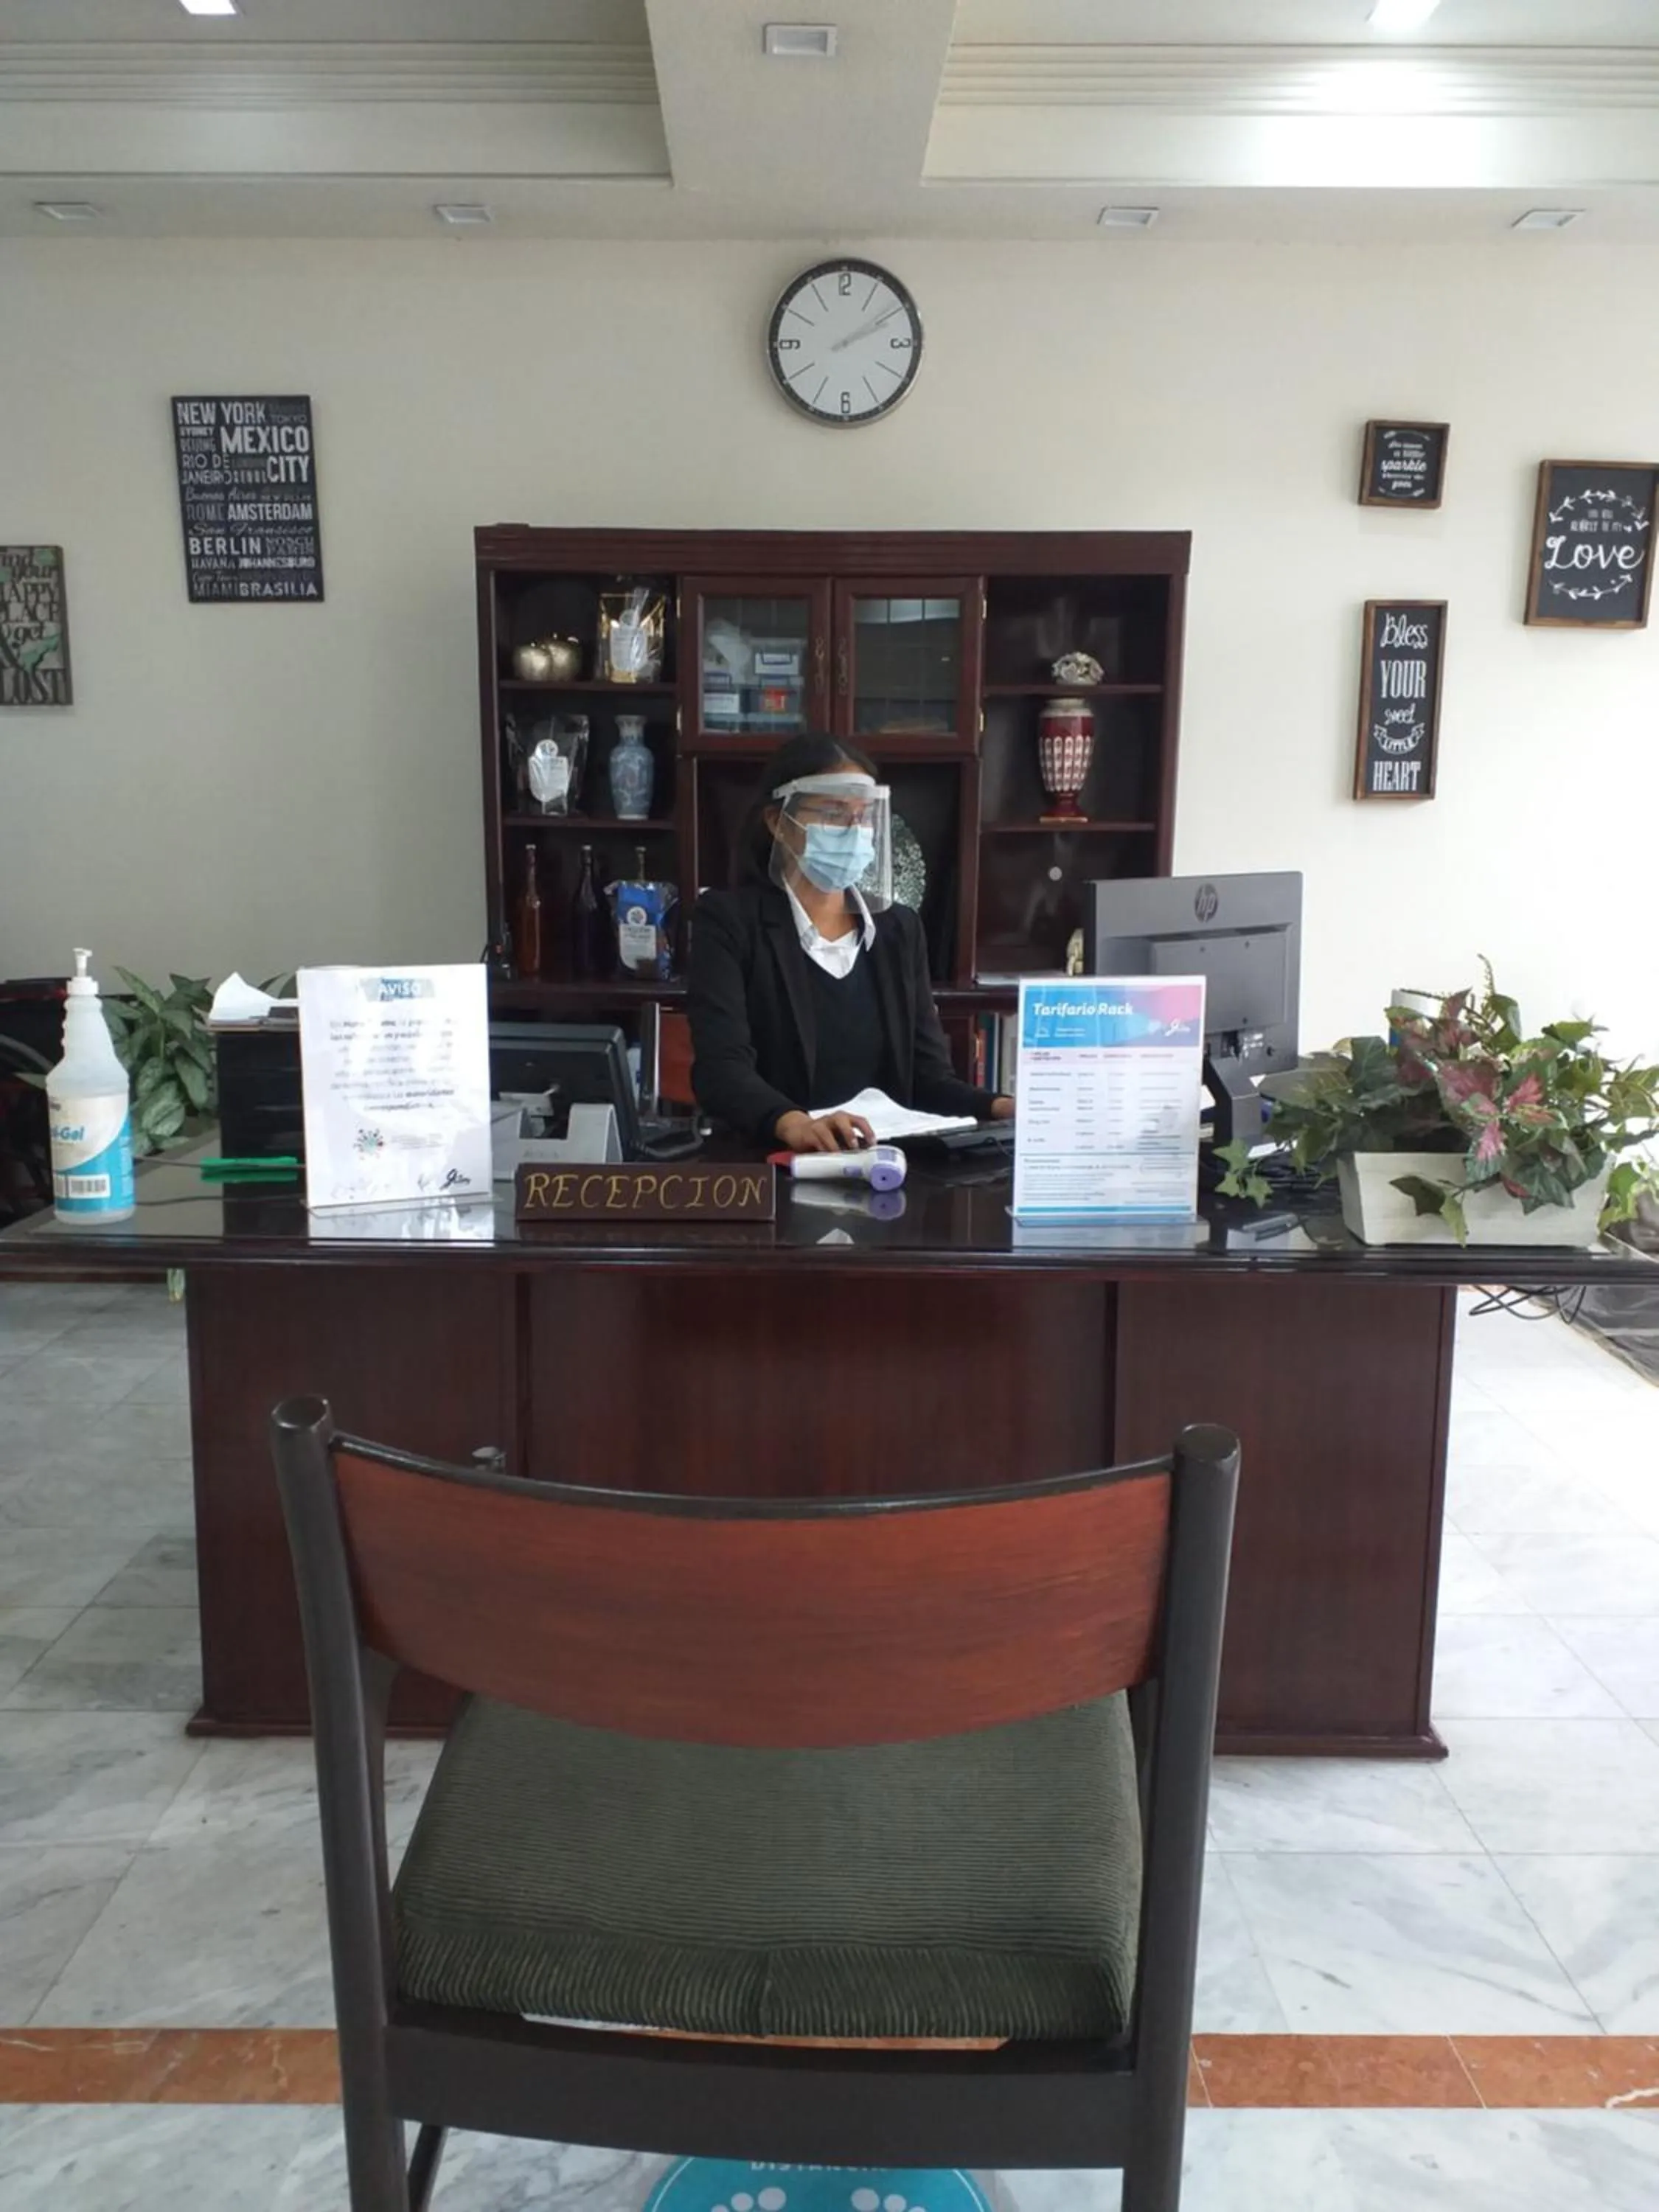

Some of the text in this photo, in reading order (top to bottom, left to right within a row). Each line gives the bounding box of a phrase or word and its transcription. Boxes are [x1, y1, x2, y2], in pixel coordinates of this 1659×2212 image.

[890, 338, 911, 349] 3
[176, 403, 215, 425] NEW
[220, 402, 265, 425] YORK
[841, 392, 850, 414] 6
[221, 425, 310, 453] MEXICO
[183, 454, 207, 469] RIO
[267, 456, 310, 483] CITY
[227, 503, 313, 521] AMSTERDAM
[189, 537, 261, 555] BERLIN
[1544, 535, 1645, 570] Love
[240, 582, 317, 597] BRASILIA
[1380, 660, 1427, 698] YOUR
[1372, 760, 1421, 791] HEART
[1034, 1002, 1133, 1018] Tarifario Rack
[524, 1172, 767, 1208] RECEPCION
